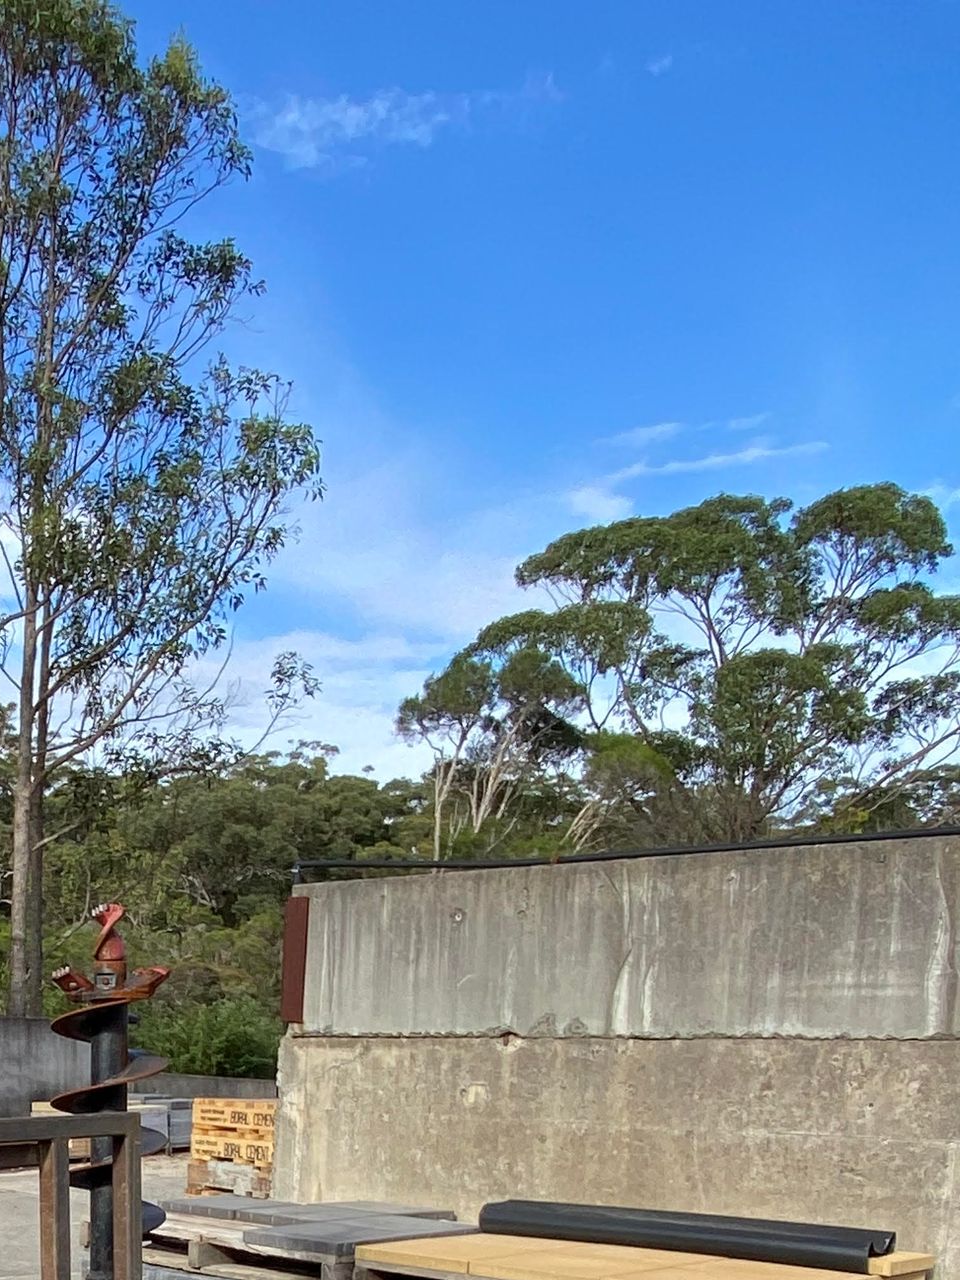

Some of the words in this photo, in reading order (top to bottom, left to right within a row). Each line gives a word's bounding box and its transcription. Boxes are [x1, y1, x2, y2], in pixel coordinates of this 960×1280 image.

[230, 1111, 249, 1125] BORAL
[223, 1142, 243, 1159] BORAL
[245, 1144, 270, 1161] CEMENT
